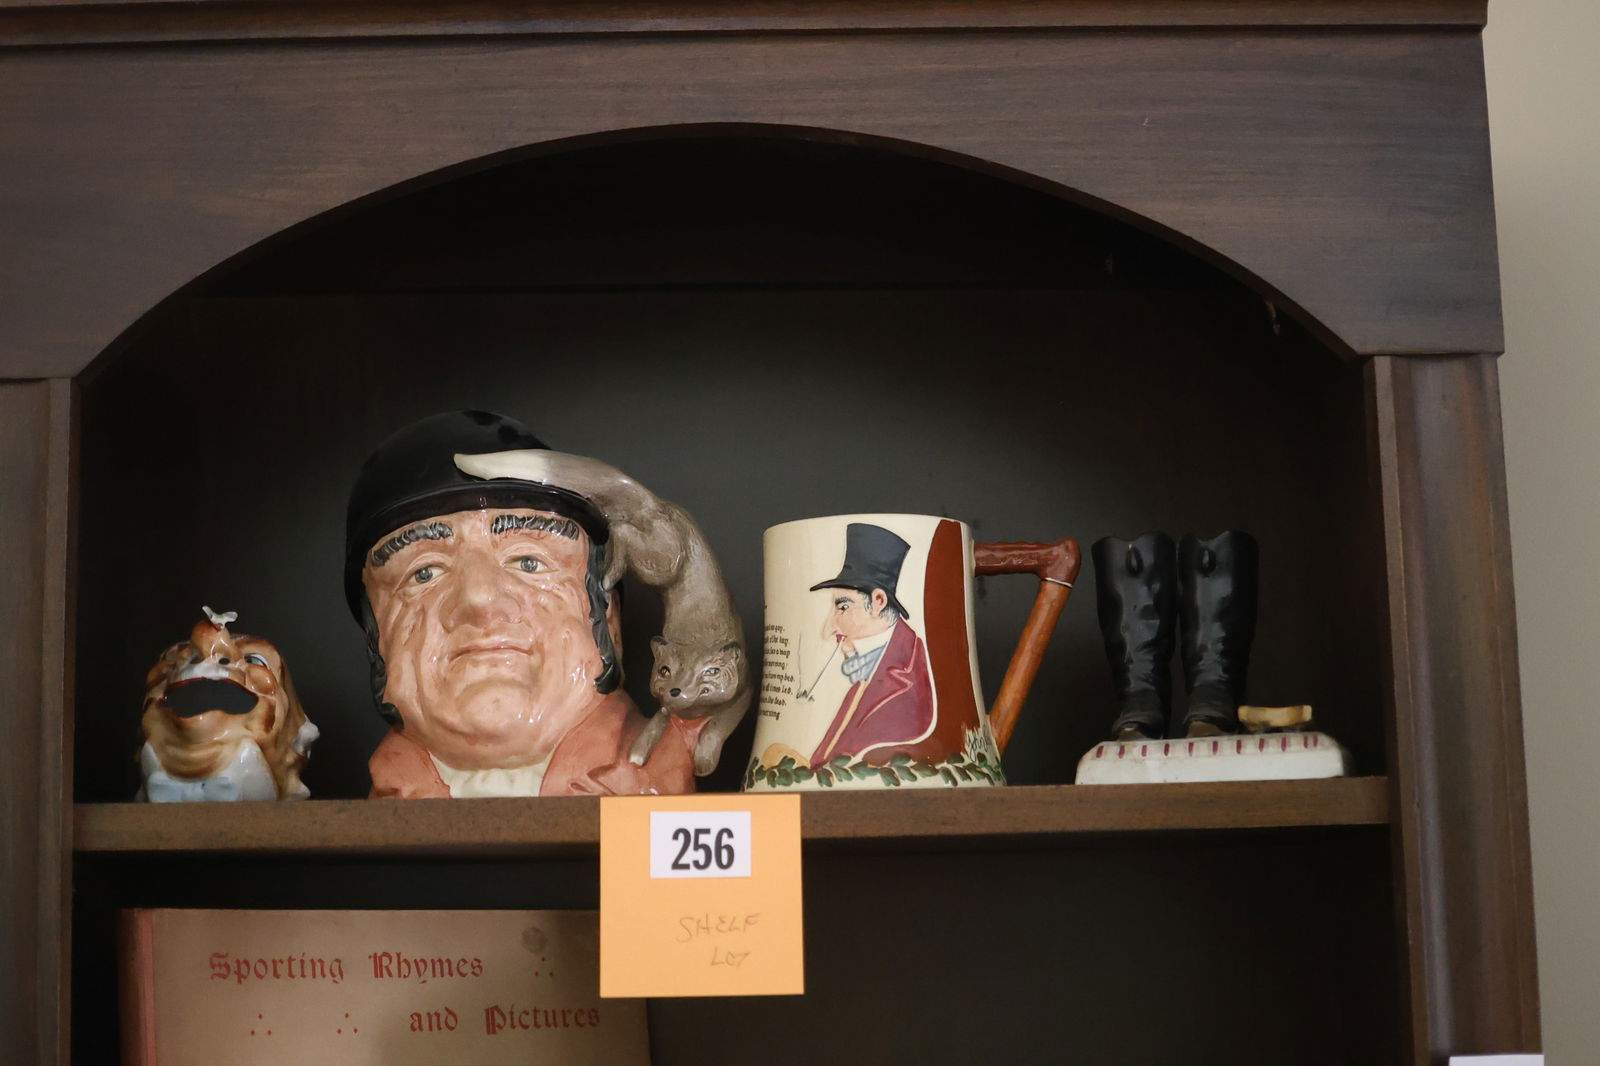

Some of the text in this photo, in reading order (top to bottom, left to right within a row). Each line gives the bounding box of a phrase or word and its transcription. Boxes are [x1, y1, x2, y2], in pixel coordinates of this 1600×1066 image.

[671, 827, 735, 871] 256
[676, 912, 761, 943] SHELF
[208, 951, 484, 984] Sporting Rhymes
[710, 946, 752, 971] LOT
[409, 1004, 601, 1035] and Pictures
